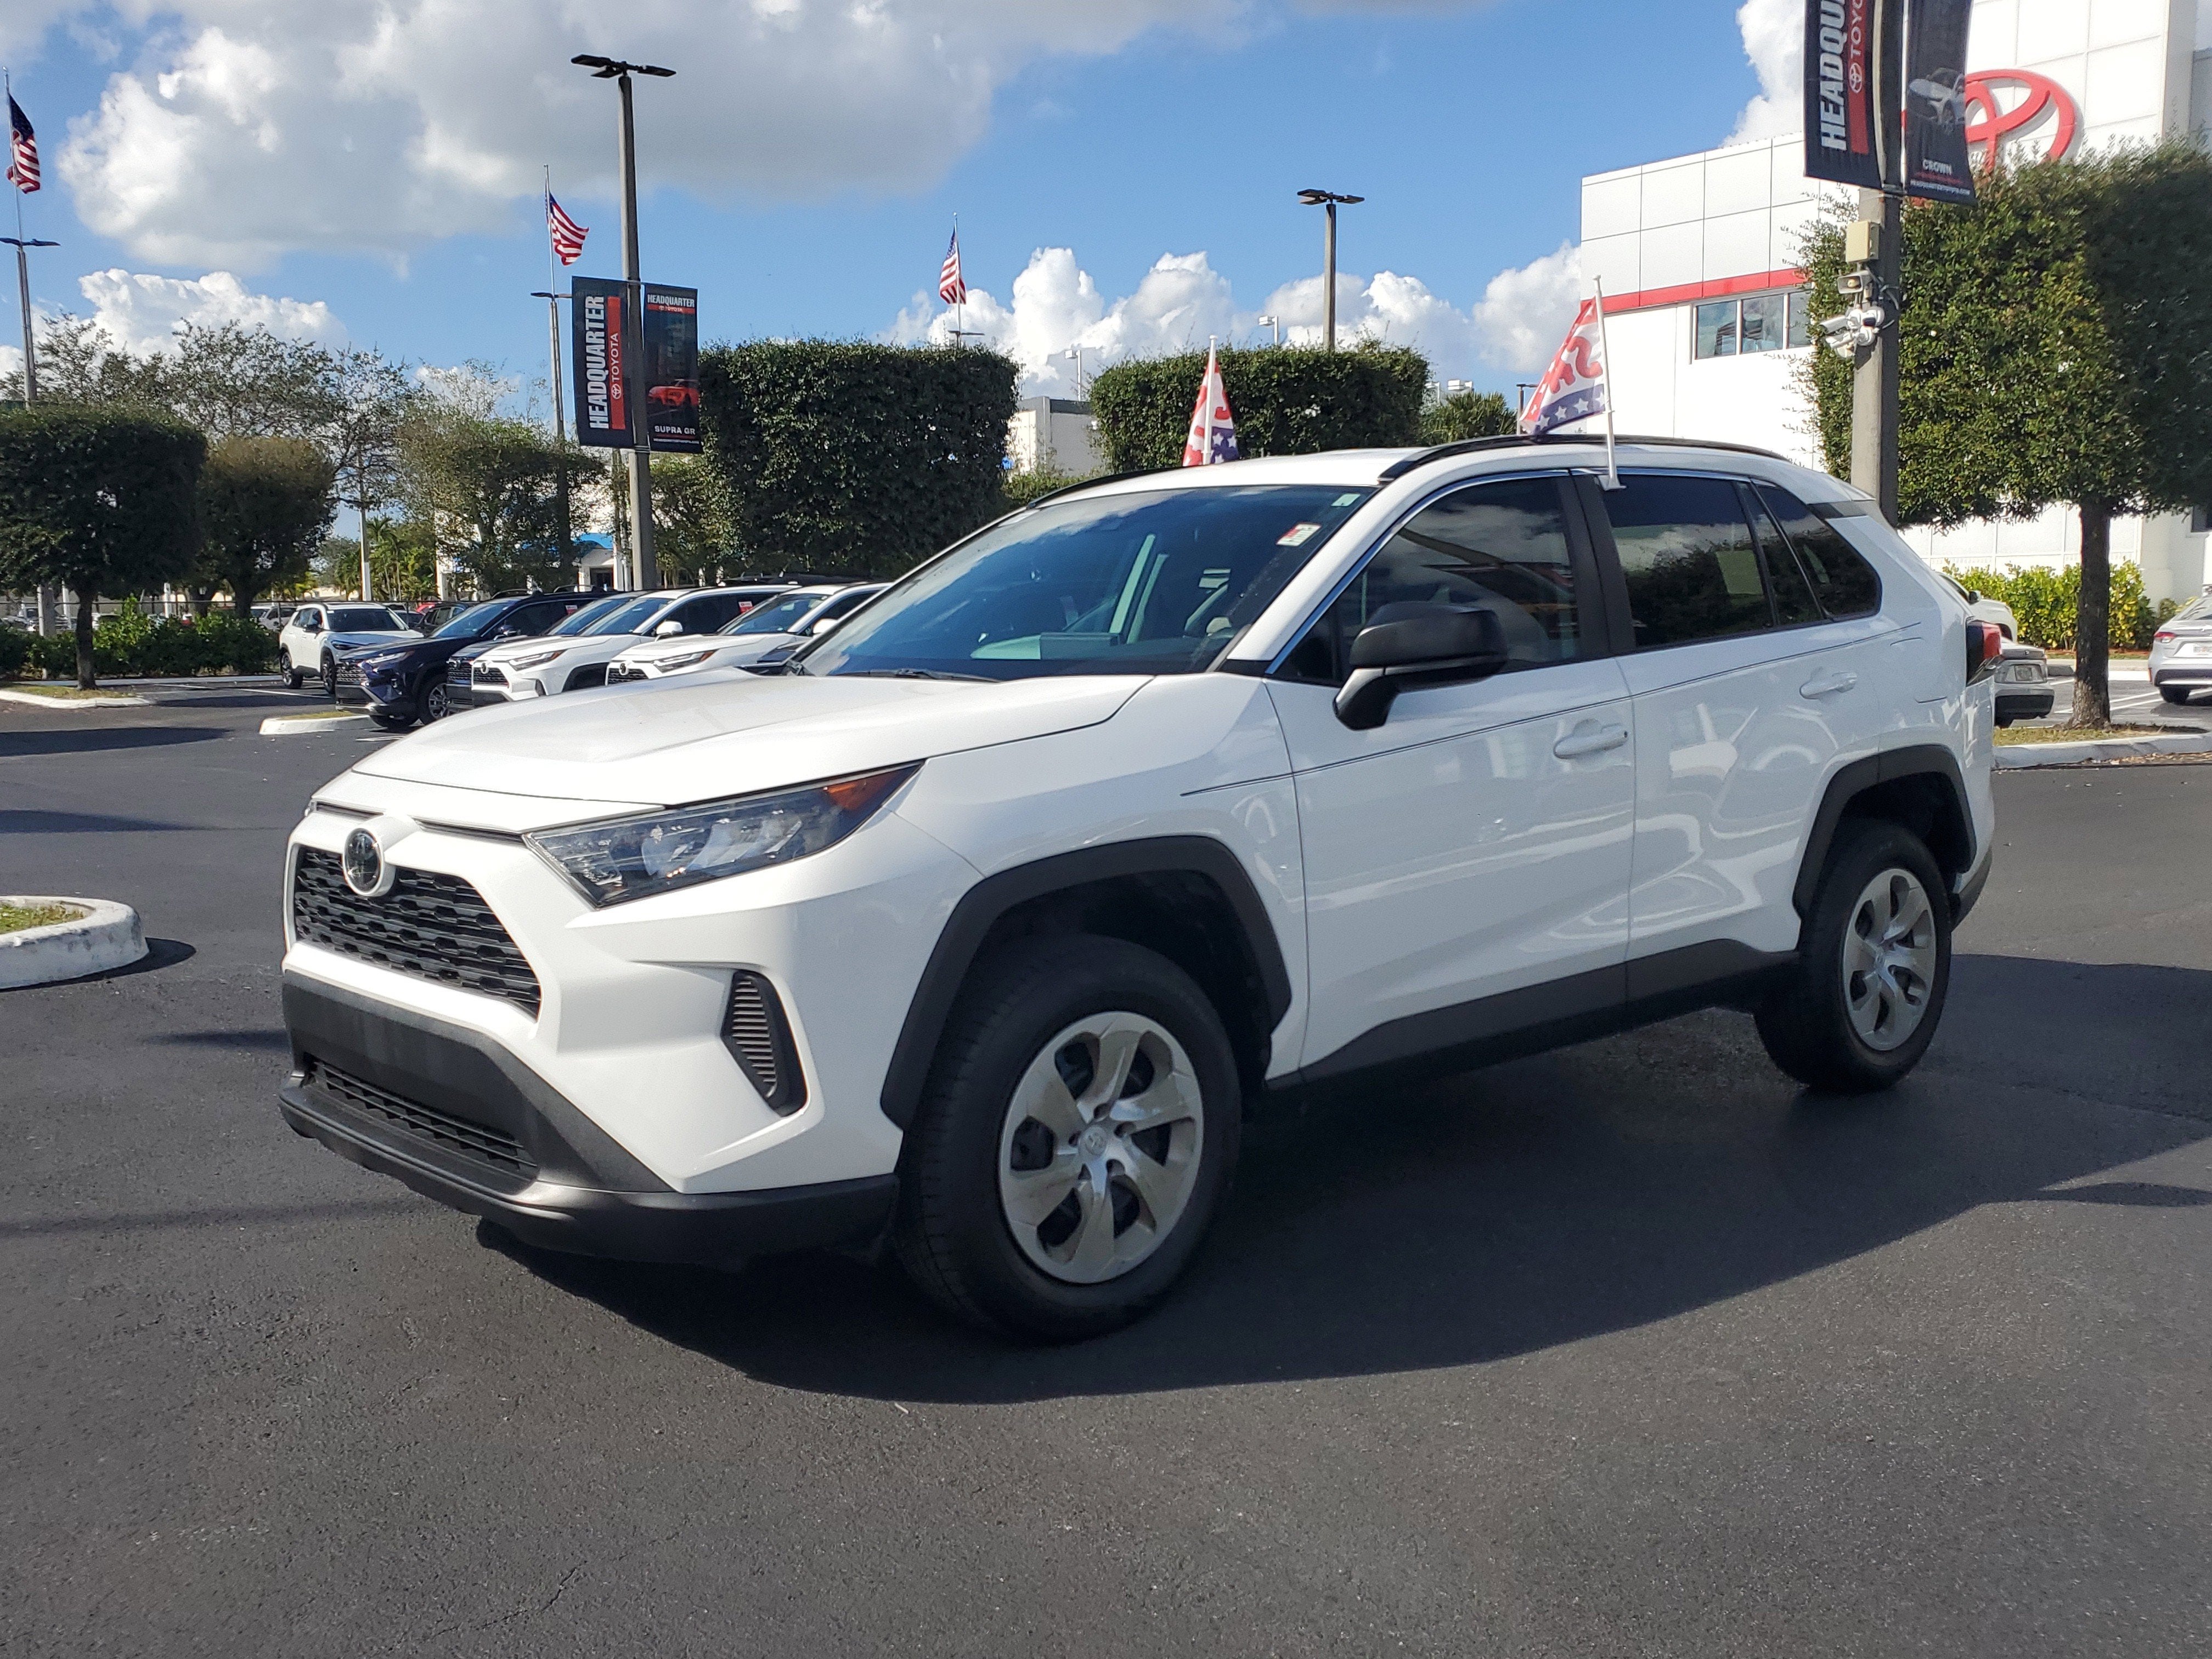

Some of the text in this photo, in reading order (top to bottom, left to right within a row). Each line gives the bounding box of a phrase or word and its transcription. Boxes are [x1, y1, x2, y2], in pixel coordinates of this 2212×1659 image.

[1820, 0, 1848, 151] HEADQU
[647, 294, 695, 308] HEADQUARTER
[585, 295, 610, 429] HEADQUARTER
[611, 332, 619, 382] TOYOTA
[654, 426, 682, 435] SUPRA
